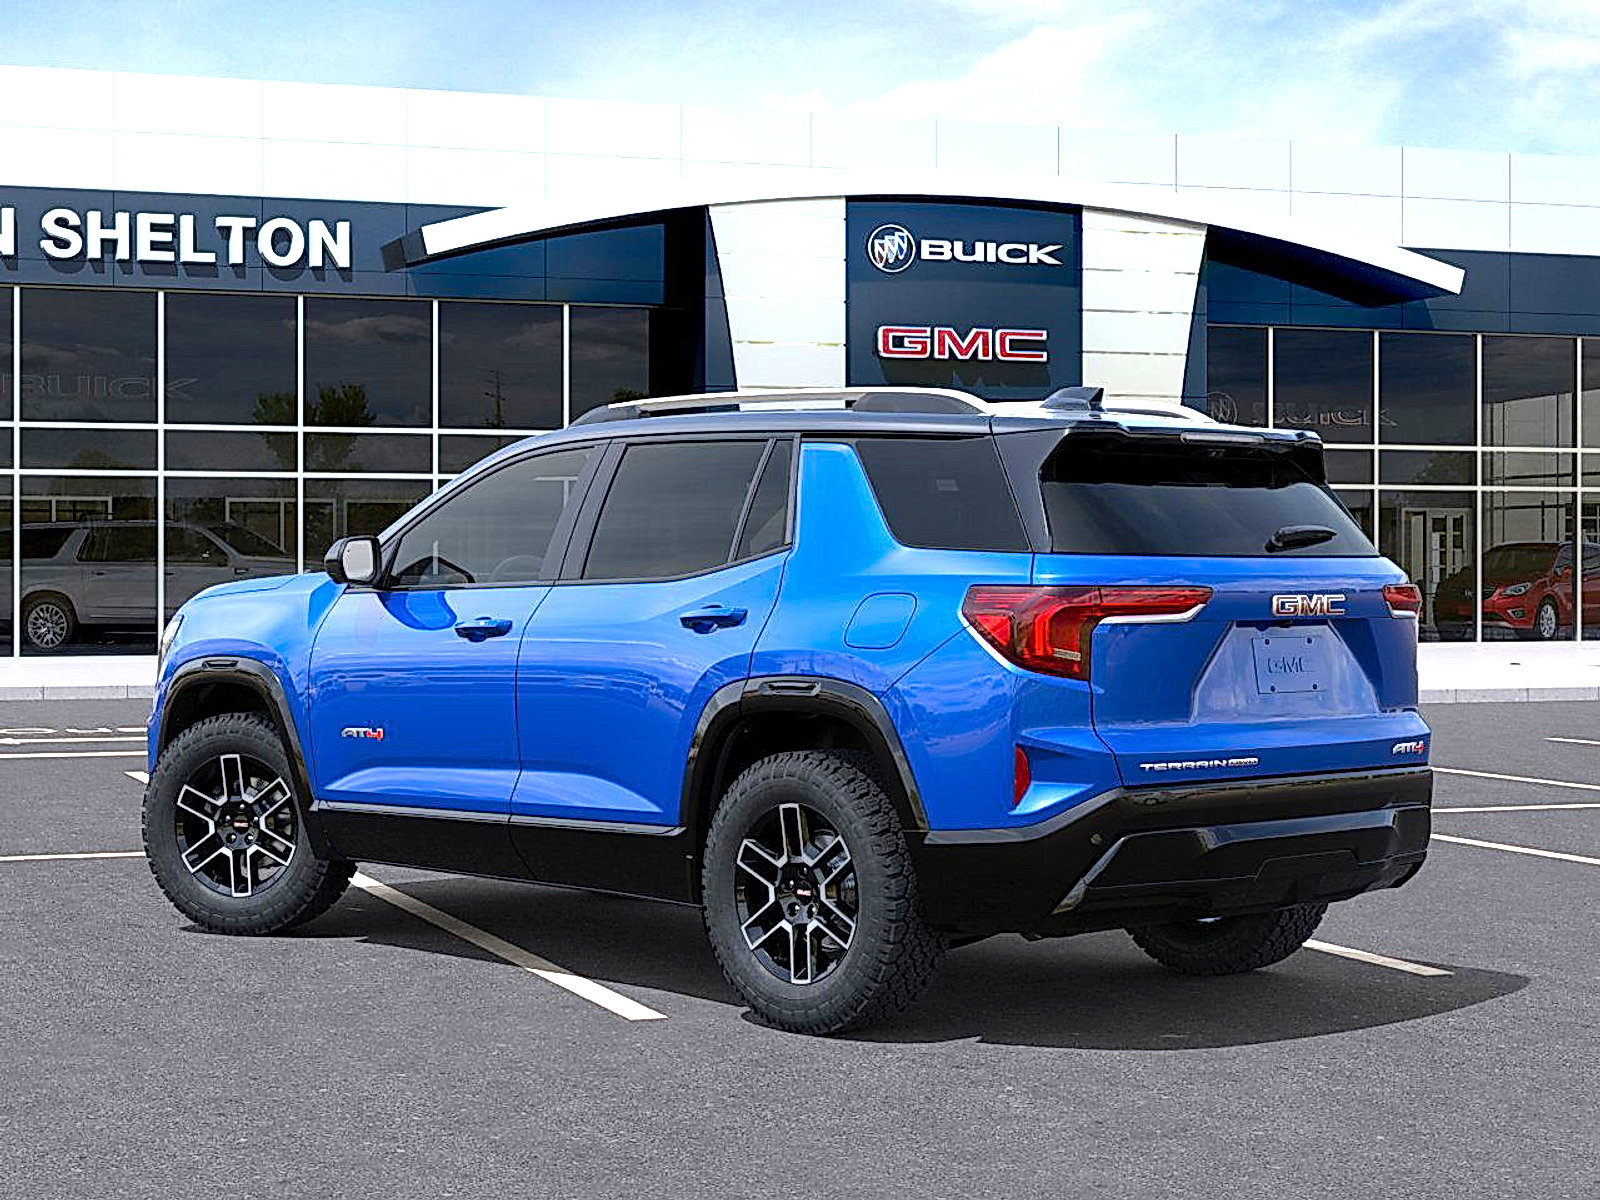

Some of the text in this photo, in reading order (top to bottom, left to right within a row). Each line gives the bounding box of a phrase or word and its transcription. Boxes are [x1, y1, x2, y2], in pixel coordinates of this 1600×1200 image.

[40, 208, 350, 268] SHELTON
[920, 239, 1063, 266] BUICK
[877, 325, 1048, 362] GMC
[1272, 594, 1346, 616] GMC
[1267, 655, 1317, 674] GMC
[341, 727, 384, 741] AT4
[1392, 740, 1424, 755] AT4
[1139, 760, 1227, 771] TERRAIN
